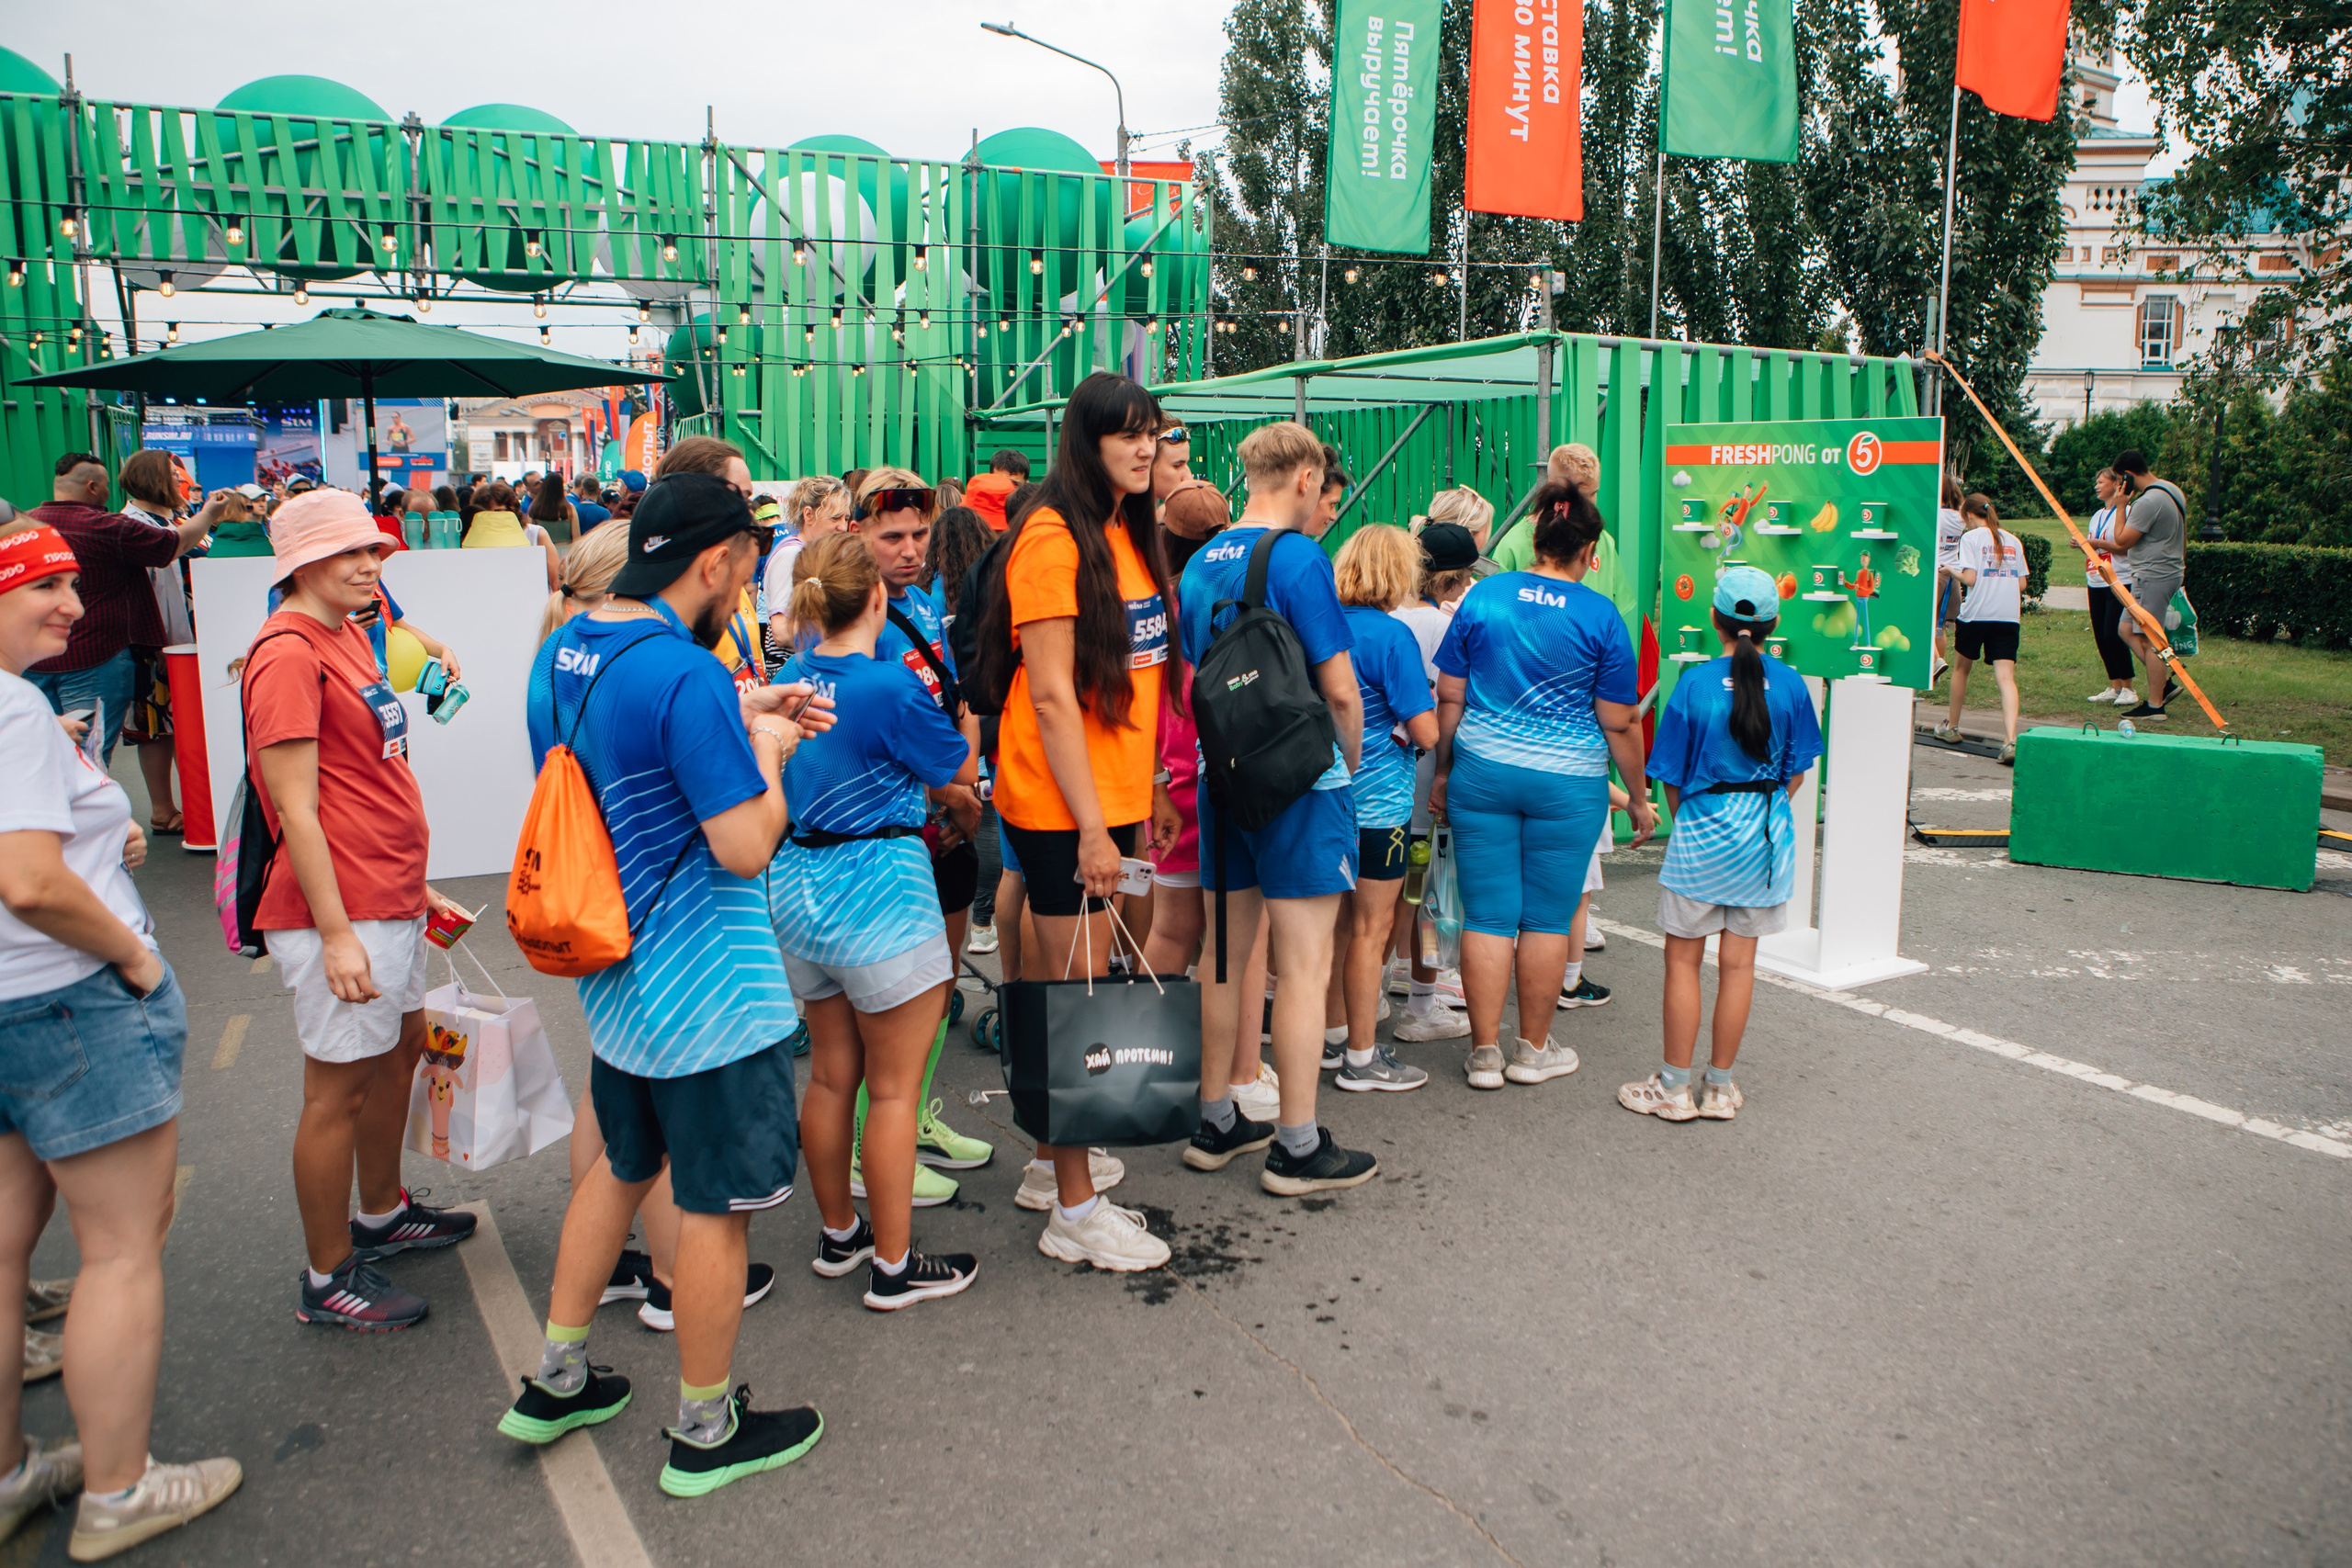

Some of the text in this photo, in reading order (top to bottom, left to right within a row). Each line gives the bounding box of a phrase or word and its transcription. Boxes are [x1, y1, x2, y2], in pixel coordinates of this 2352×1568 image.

[1360, 16, 1385, 177] выручает!
[1386, 21, 1415, 180] Пятёрочка
[1504, 34, 1532, 141] минут
[641, 421, 654, 479] ДОПЫТ
[1711, 444, 1815, 465] FRESHPONG
[1134, 612, 1168, 642] 5584
[379, 702, 403, 728] 3557
[1085, 1047, 1173, 1069] ХАЙ ПРОТЕИН!
